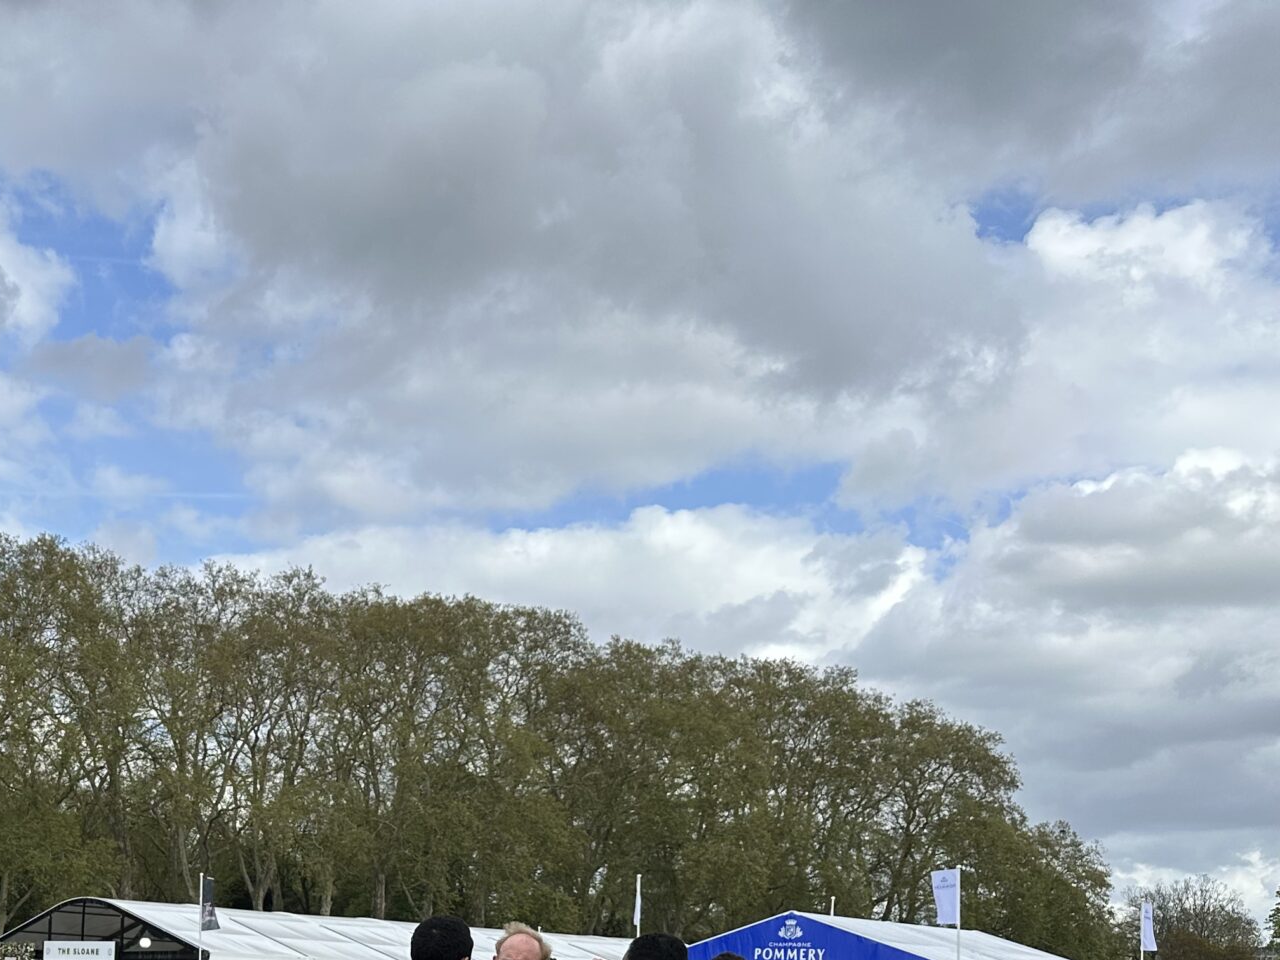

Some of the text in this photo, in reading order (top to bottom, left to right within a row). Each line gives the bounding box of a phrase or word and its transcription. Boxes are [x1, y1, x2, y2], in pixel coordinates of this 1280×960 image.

[57, 947, 100, 956] THE SLOANE
[754, 947, 826, 960] POMMERY
